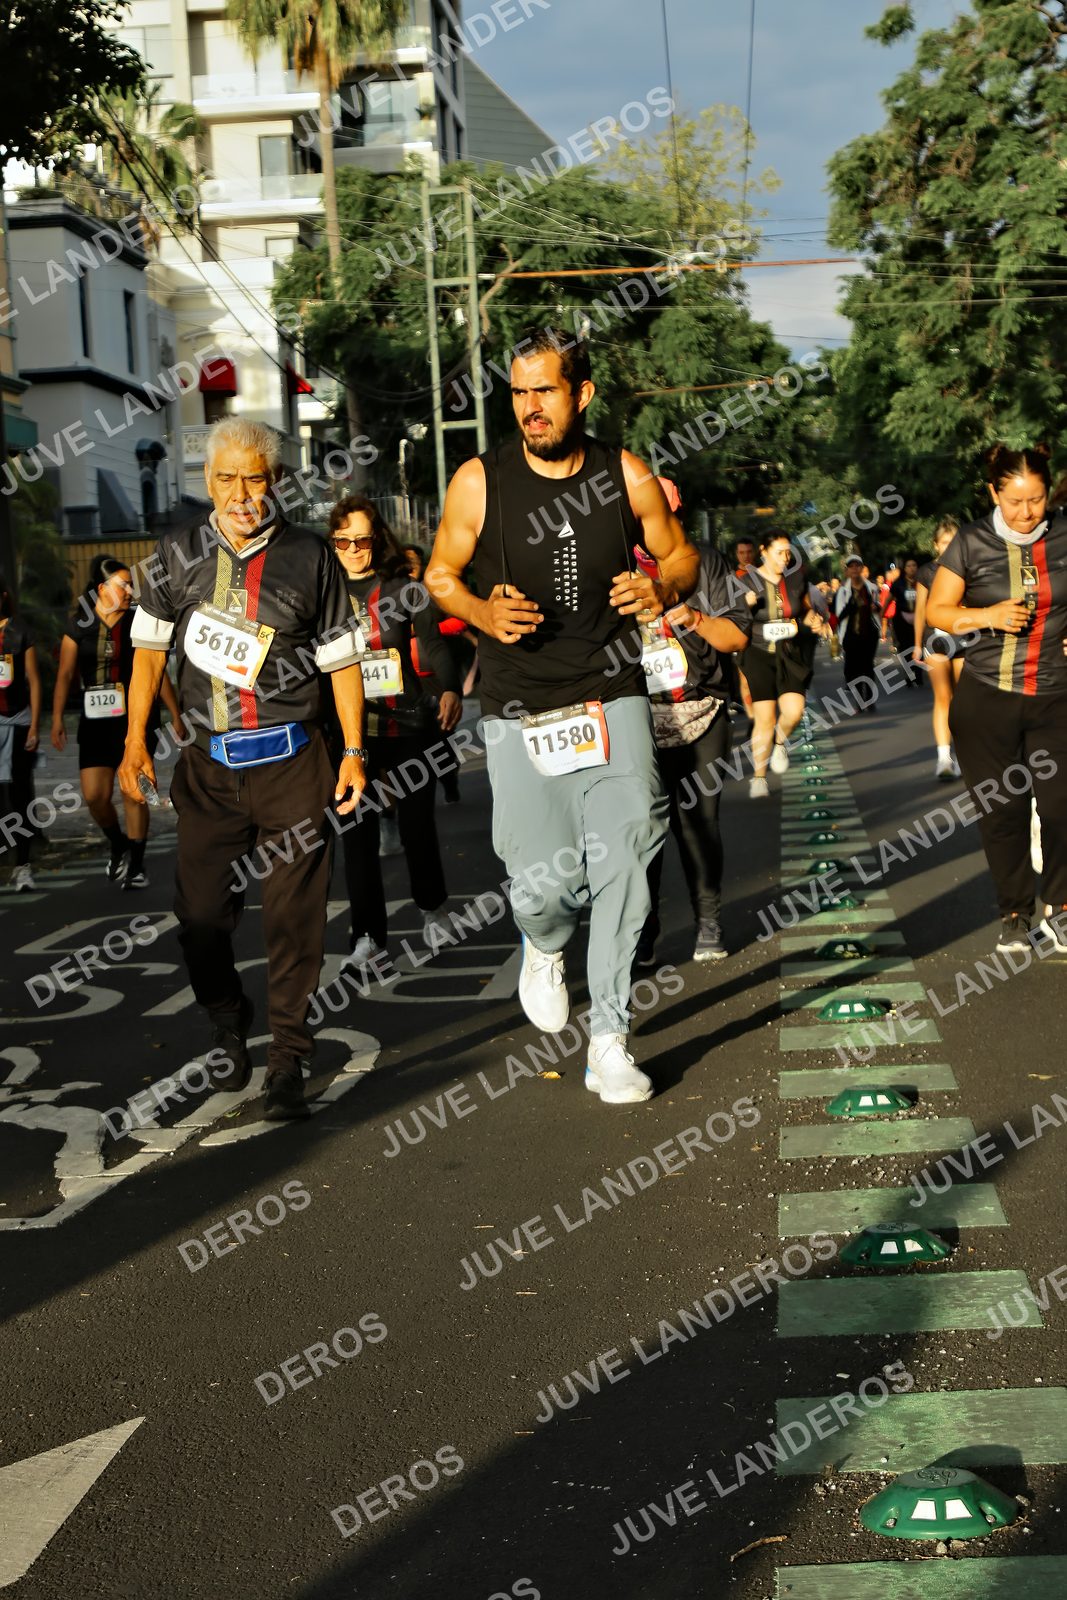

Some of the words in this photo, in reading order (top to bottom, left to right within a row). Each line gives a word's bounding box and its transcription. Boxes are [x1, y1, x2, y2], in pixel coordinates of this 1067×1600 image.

[553, 551, 561, 601] INIZIO
[563, 546, 571, 607] YESTERDAY
[570, 539, 578, 580] HARDER
[194, 624, 249, 662] 5618
[89, 694, 116, 706] 3120
[528, 723, 596, 756] 11580
